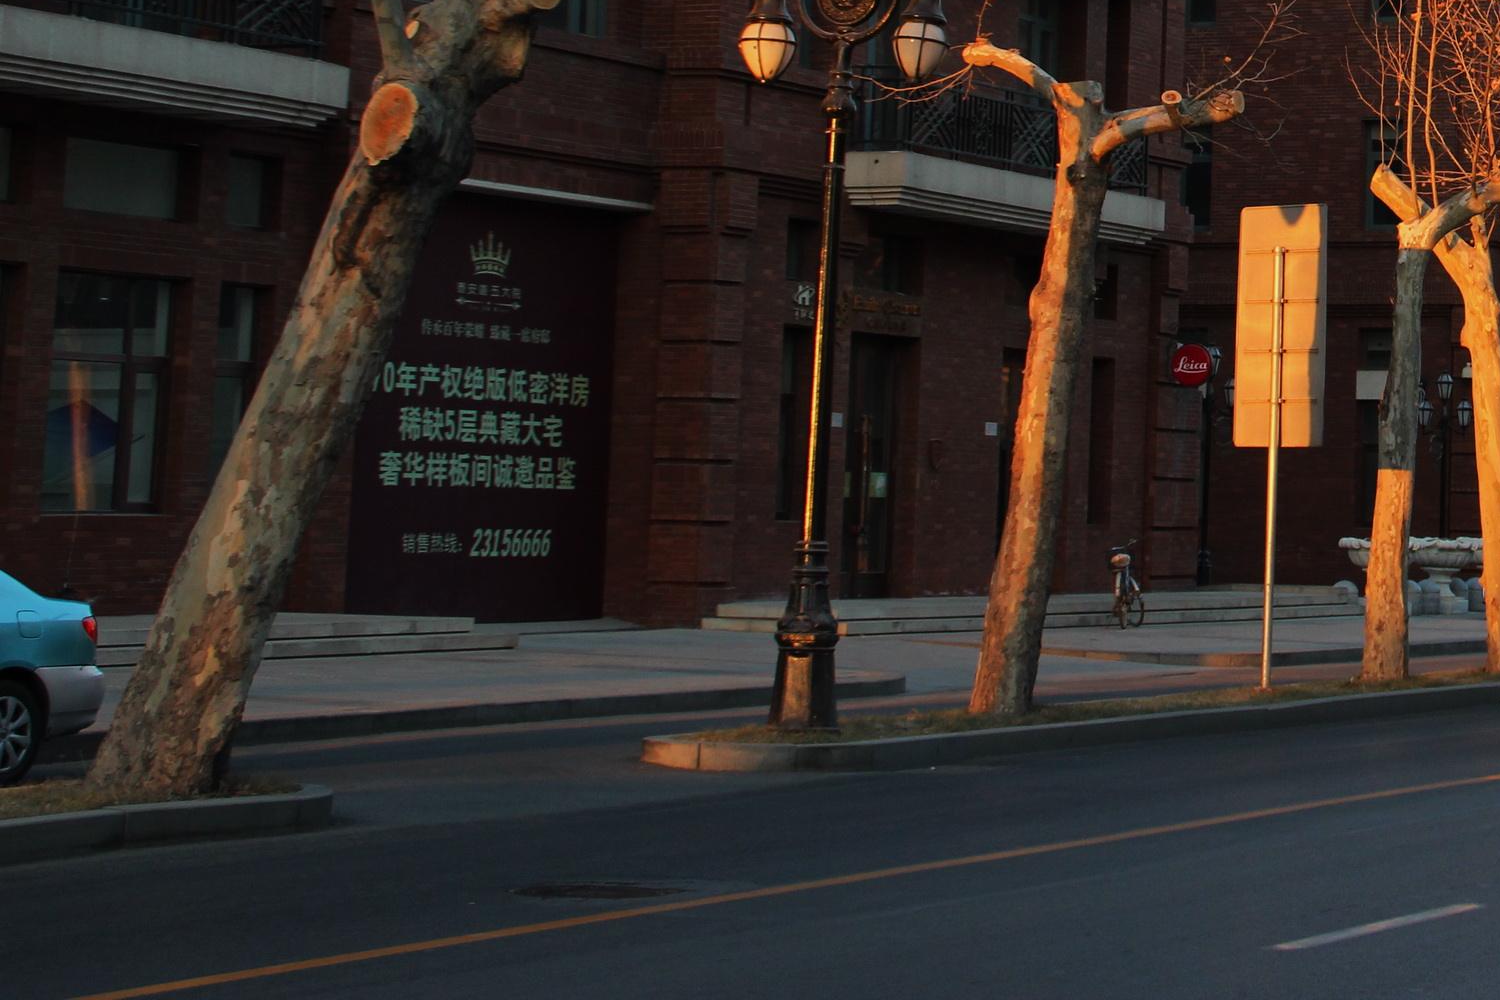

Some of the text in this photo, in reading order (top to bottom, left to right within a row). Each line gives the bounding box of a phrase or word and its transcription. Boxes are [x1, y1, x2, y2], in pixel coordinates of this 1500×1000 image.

[1173, 356, 1208, 373] Leica
[398, 406, 564, 448] 稀缺5层典藏大宅
[378, 450, 577, 490] 奢华样板间诚邀品鉴
[469, 528, 553, 557] 23156666
